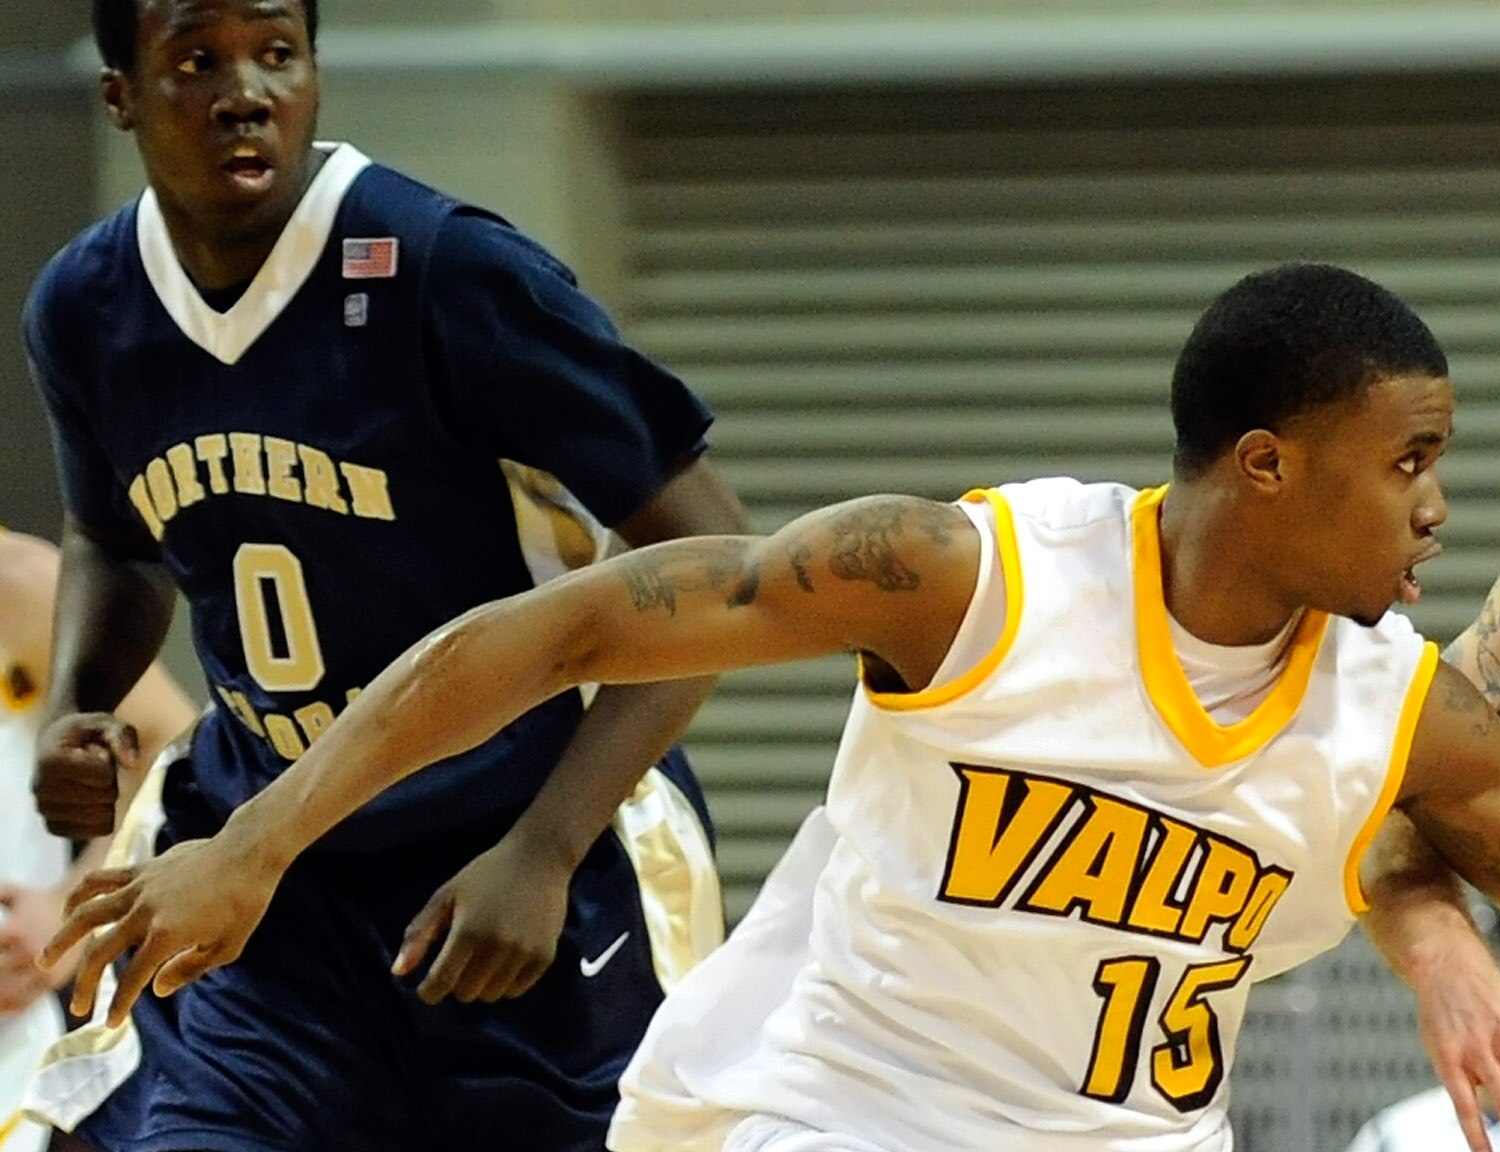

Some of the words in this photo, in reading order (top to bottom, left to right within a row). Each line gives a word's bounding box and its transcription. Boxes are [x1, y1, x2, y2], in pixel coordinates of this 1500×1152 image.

[129, 432, 395, 542] NORTHERN
[233, 543, 325, 692] 0
[937, 761, 1294, 955] VALPO
[1078, 954, 1253, 1112] 15
